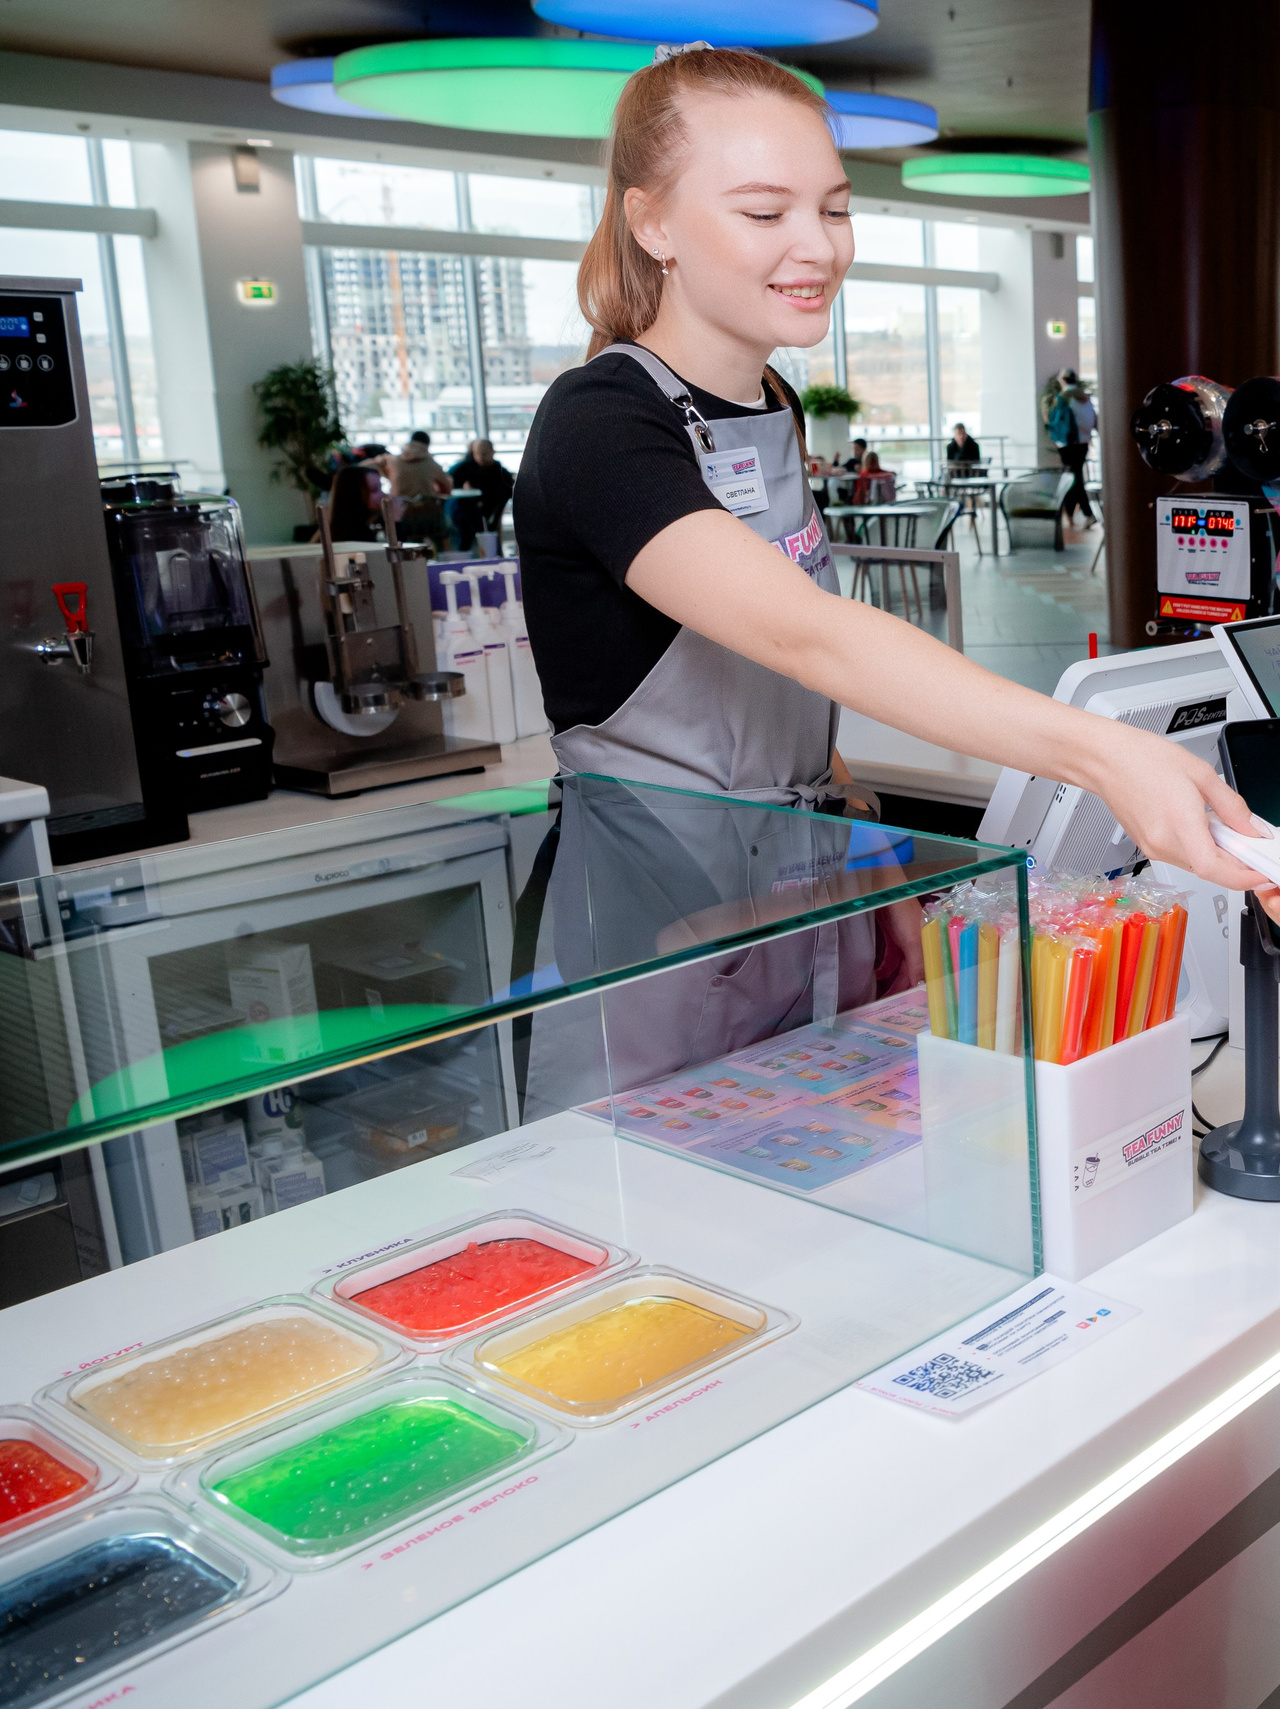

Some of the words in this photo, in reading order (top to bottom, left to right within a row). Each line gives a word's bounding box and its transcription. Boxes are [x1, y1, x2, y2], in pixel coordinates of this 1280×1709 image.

[726, 487, 755, 499] СВЕТЛАНА
[1124, 1137, 1146, 1160] TEA
[1145, 1112, 1183, 1147] FUNNY
[1127, 1151, 1150, 1166] BUBBLE
[1150, 1146, 1162, 1155] TEA
[1161, 1137, 1178, 1149] TIME!
[335, 1237, 414, 1269] КЛУБНИКА
[78, 1341, 145, 1370] ЙОГУРТ
[644, 1379, 724, 1423] АПЕЛЬСИН
[379, 1513, 466, 1562] ЗЕЛЕНОЕ
[467, 1475, 540, 1514] ЯБЛОКО
